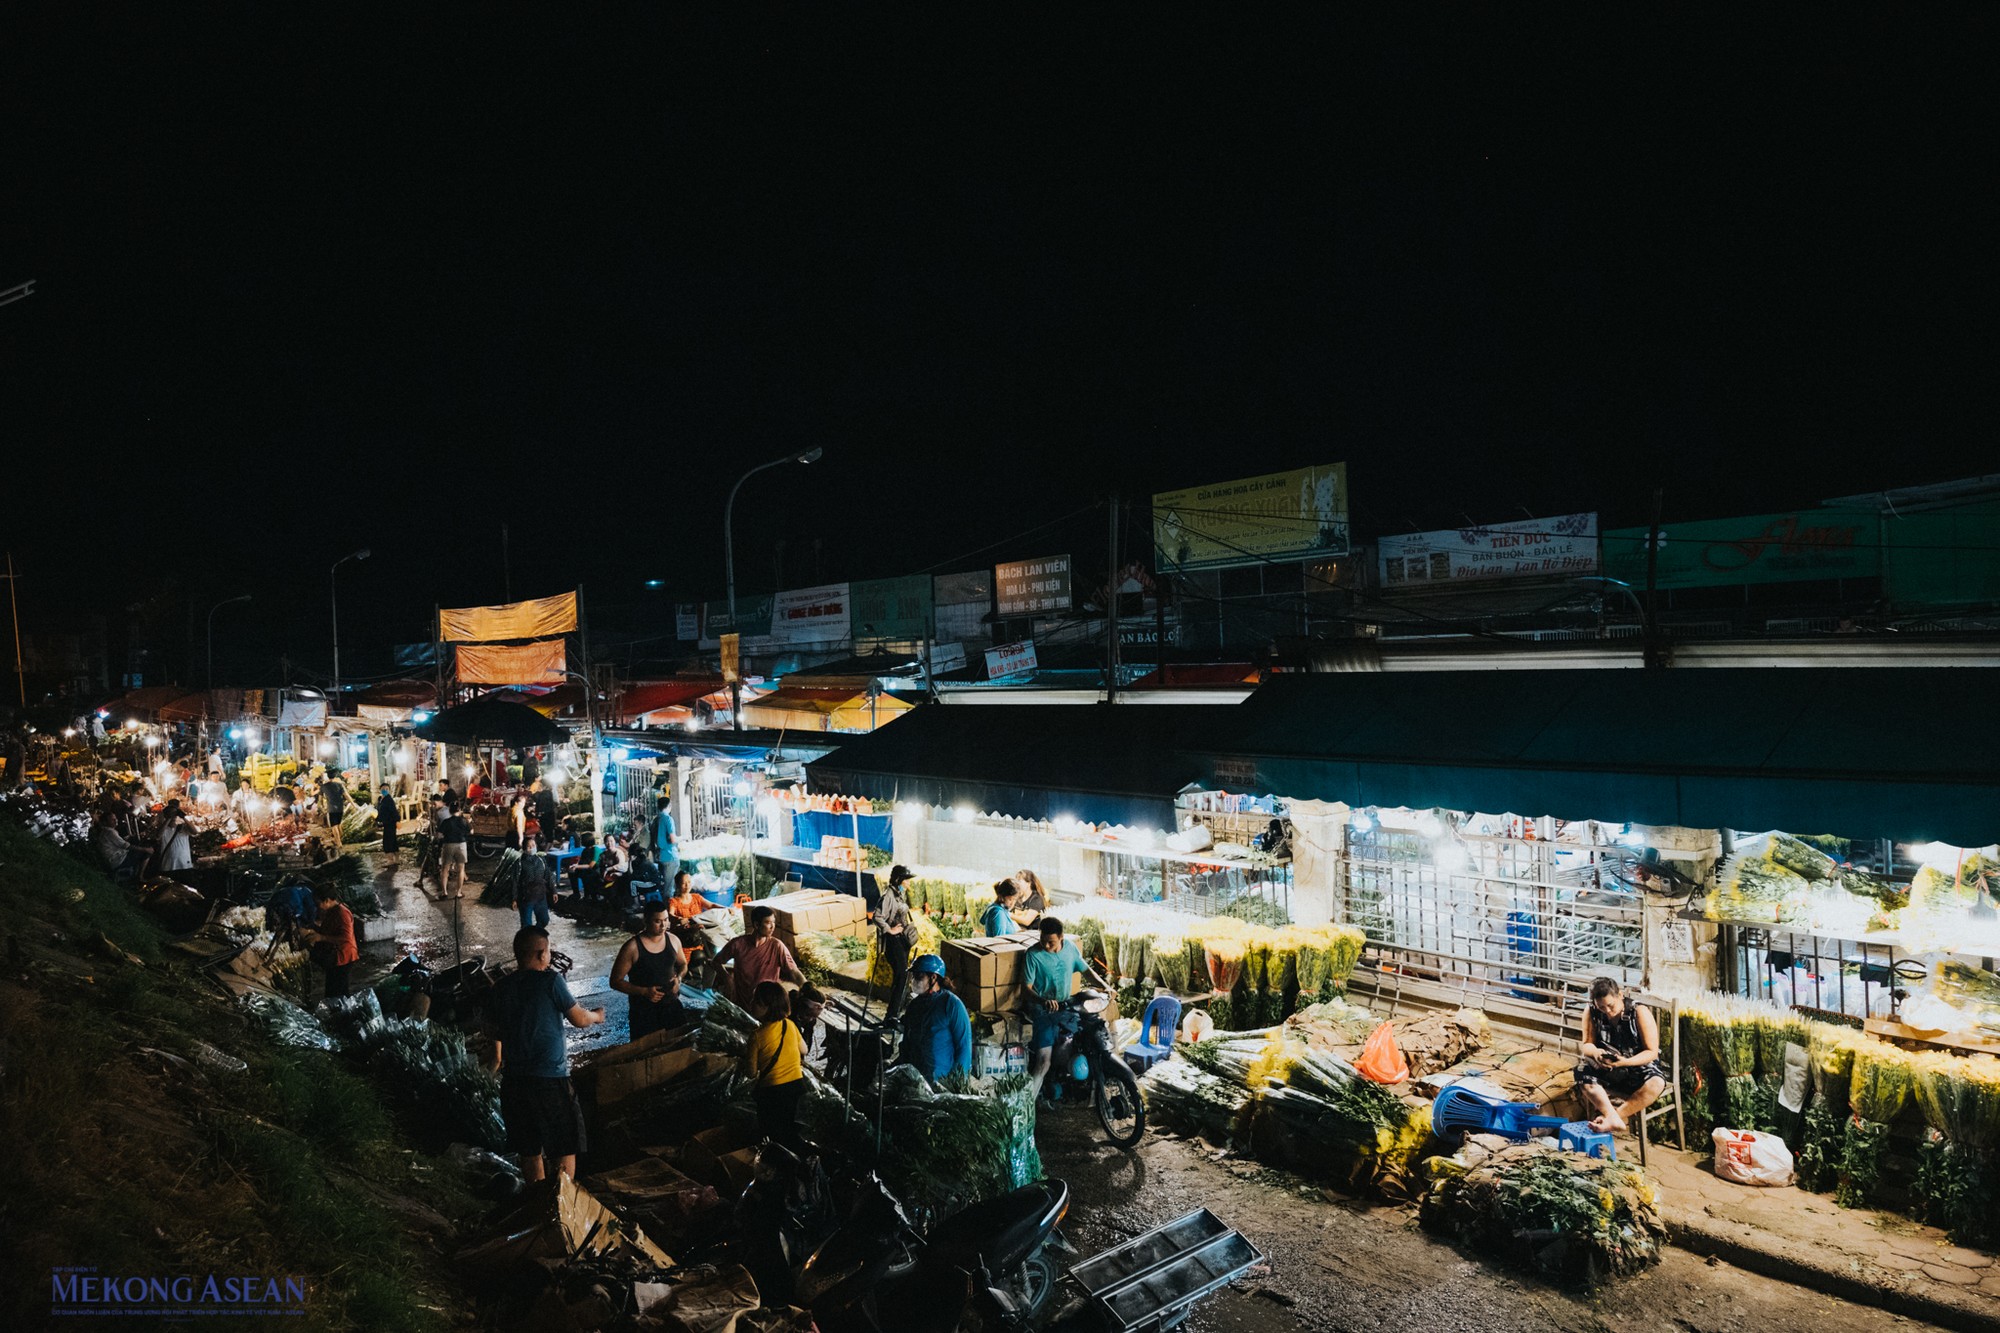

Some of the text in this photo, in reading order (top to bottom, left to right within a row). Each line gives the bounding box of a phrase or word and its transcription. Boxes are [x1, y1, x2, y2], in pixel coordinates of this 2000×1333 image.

[1233, 485, 1248, 495] HOA
[1249, 482, 1264, 492] CÂY
[1524, 529, 1551, 545] ĐỨC
[1472, 552, 1492, 562] BÁN
[1534, 546, 1556, 556] BÁN
[1559, 542, 1574, 554] LẺ
[998, 559, 1067, 580] BÁCH LAN VIÊN
[1480, 563, 1503, 576] Lan
[1514, 560, 1538, 572] Lan
[1006, 585, 1018, 596] HOA
[1019, 581, 1027, 595] LÁ
[1031, 581, 1044, 595] PHỤ
[1045, 578, 1061, 593] KIỆN
